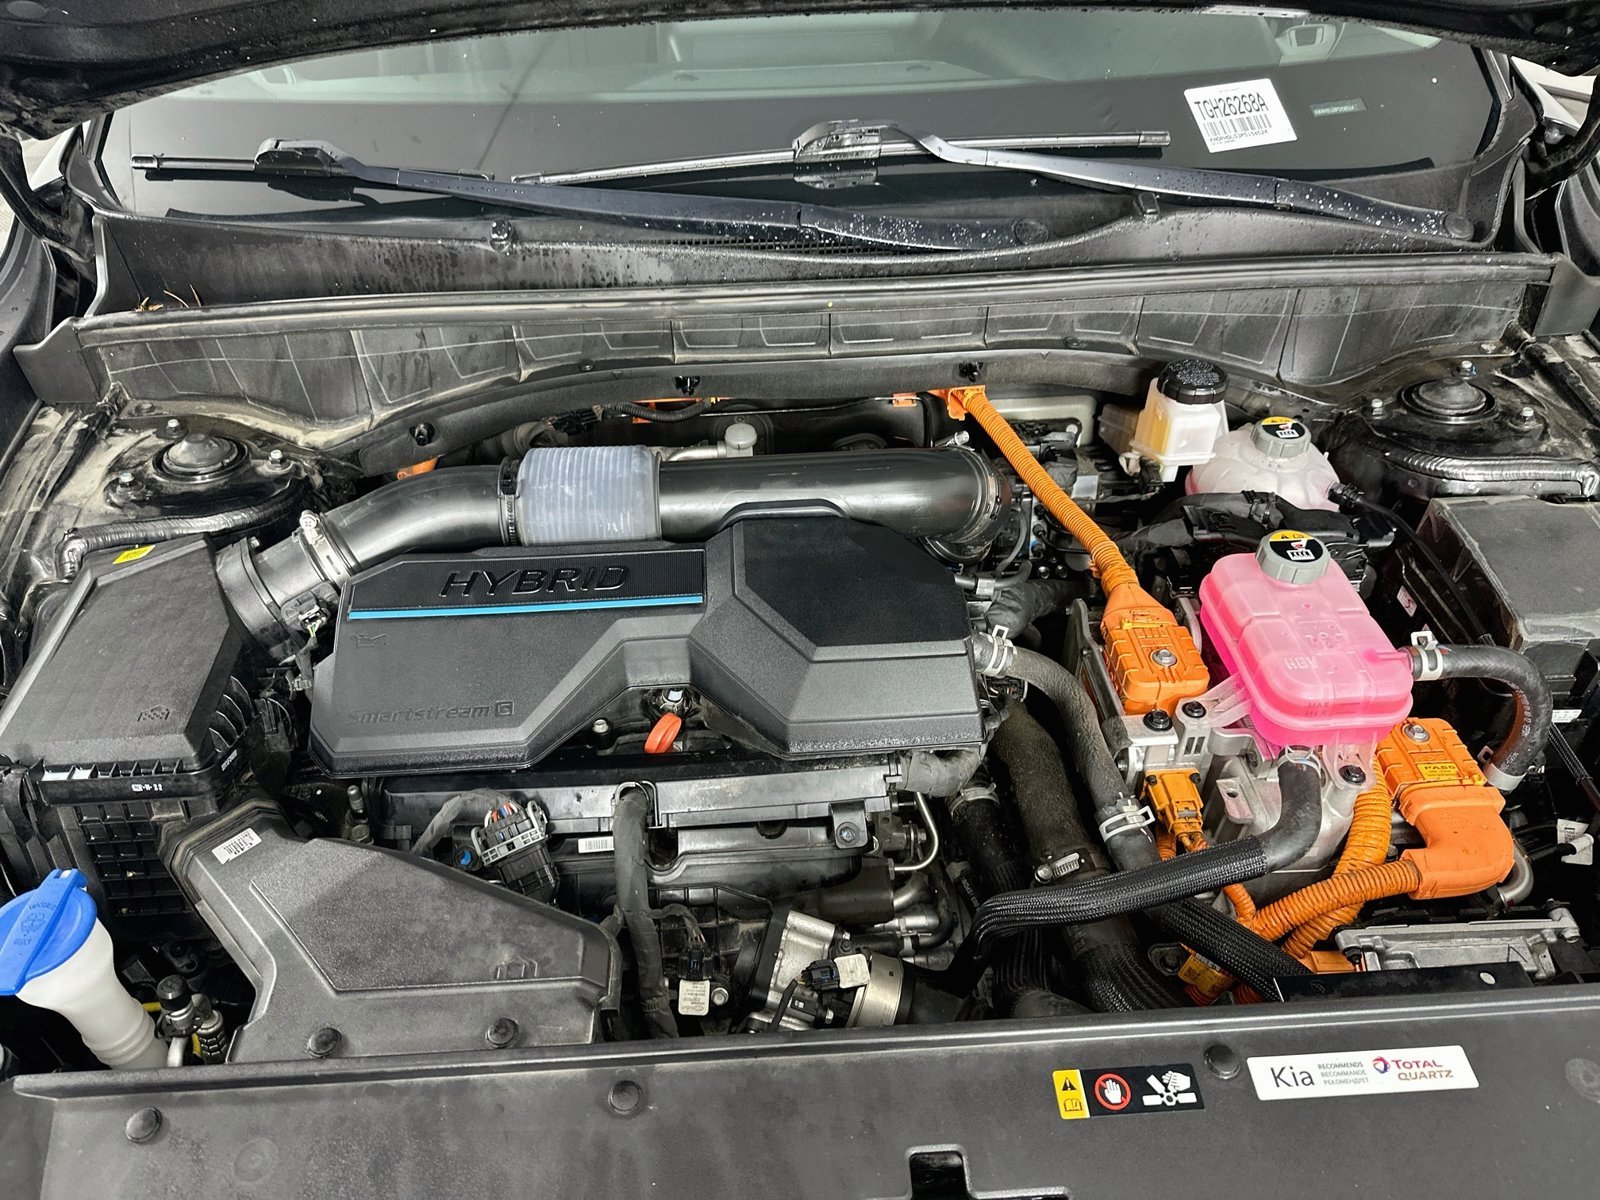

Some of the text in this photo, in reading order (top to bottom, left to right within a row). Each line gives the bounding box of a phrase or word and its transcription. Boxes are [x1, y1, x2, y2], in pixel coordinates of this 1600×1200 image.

[1194, 92, 1269, 121] TGH26268A
[439, 565, 629, 598] HYBRID
[1318, 1061, 1364, 1069] RECOMMENDS
[1391, 1059, 1443, 1070] TOTAL
[1270, 1065, 1315, 1088] Kia
[1398, 1070, 1454, 1081] QUARTZ
